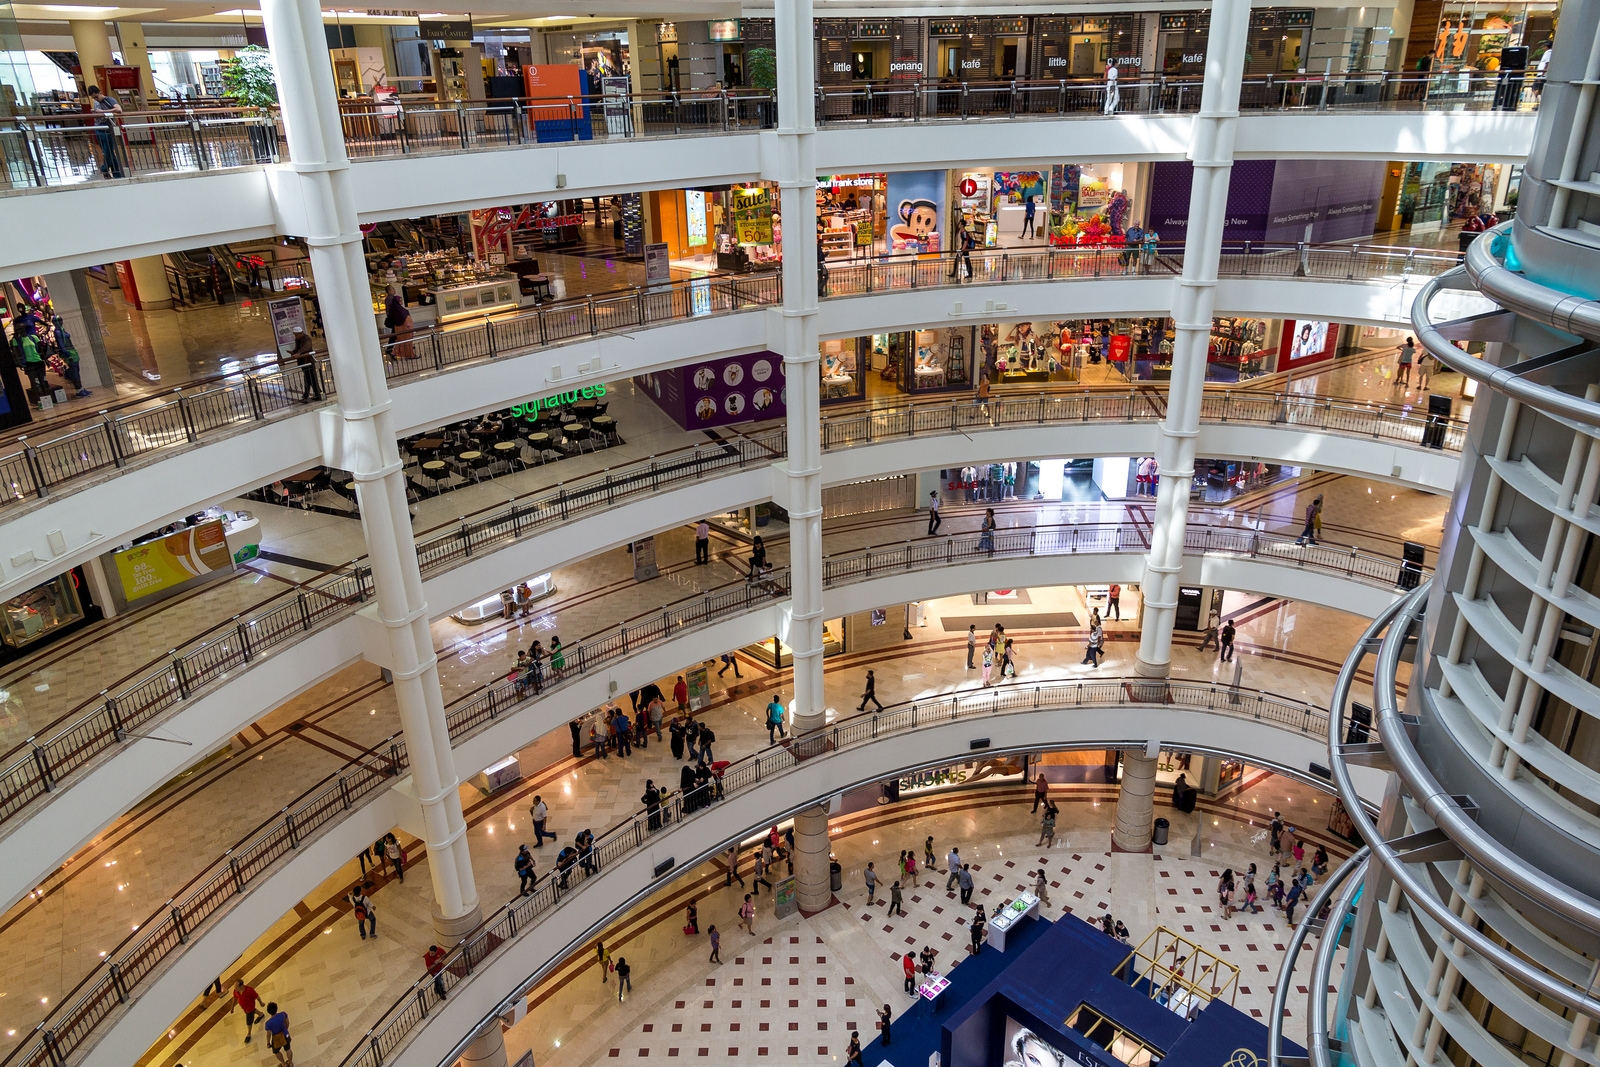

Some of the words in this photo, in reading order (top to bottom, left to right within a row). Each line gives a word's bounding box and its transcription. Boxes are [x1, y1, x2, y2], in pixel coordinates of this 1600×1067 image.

[834, 62, 852, 72] little
[890, 62, 923, 72] penang
[1048, 57, 1066, 67] little
[1107, 56, 1141, 67] pnang
[832, 178, 852, 188] frank
[853, 178, 873, 186] store
[736, 192, 768, 210] sale!
[1342, 205, 1362, 213] Something
[526, 213, 584, 230] Cinemas
[1287, 213, 1309, 222] Something
[744, 230, 768, 242] 50%
[947, 480, 979, 491] SALE
[899, 770, 967, 791] SHORTS
